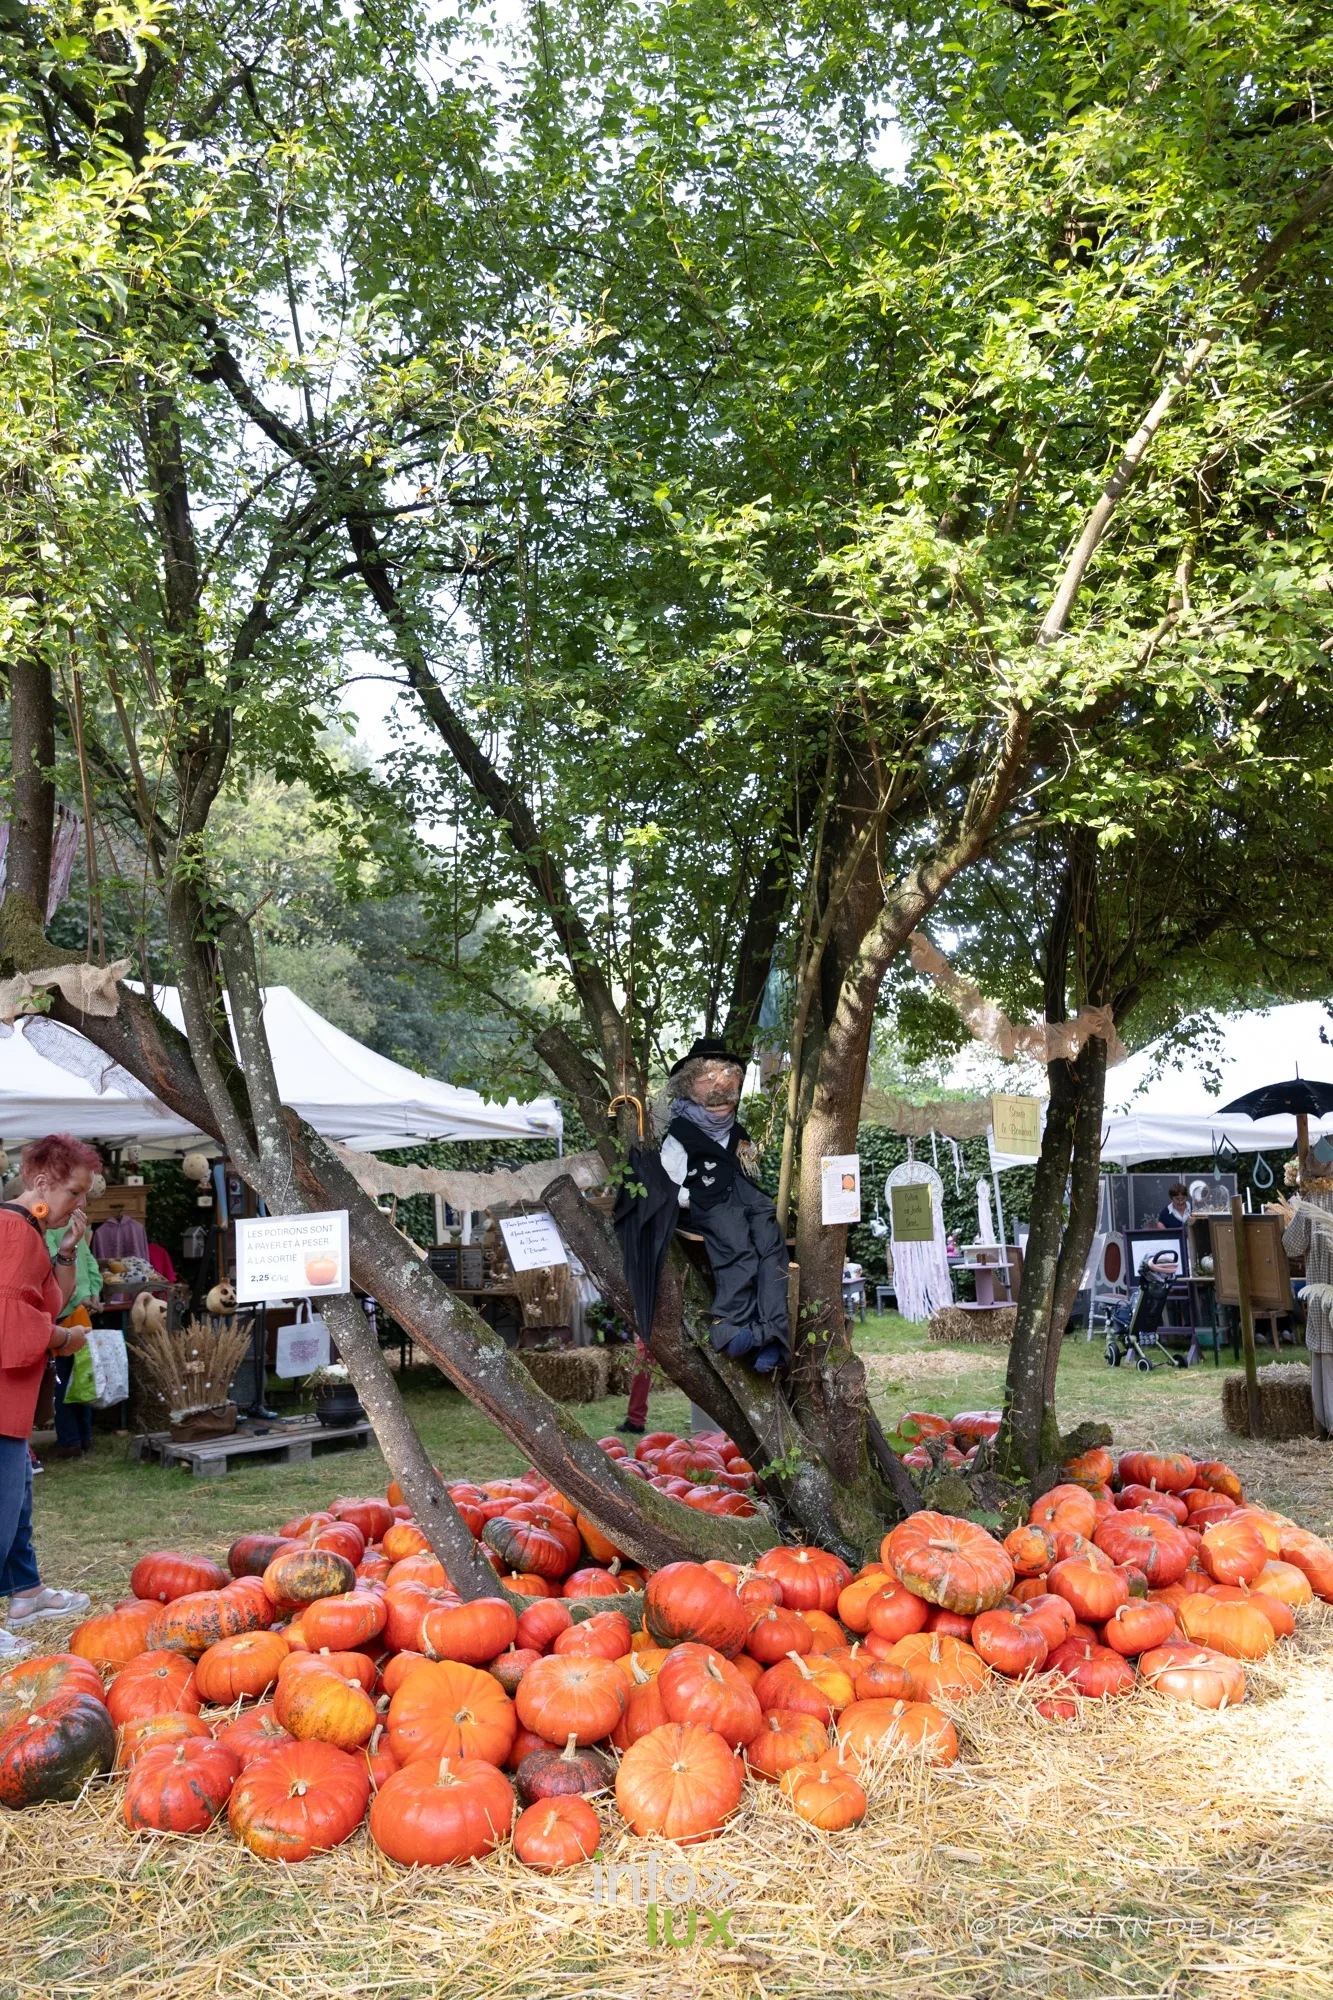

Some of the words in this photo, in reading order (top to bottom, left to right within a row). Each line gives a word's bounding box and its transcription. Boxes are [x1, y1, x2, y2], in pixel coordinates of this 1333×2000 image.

[247, 1229, 263, 1239] LES
[264, 1227, 308, 1237] POTIRONS
[310, 1224, 333, 1235] SONT
[255, 1241, 281, 1251] PAYER
[283, 1240, 293, 1249] ET
[302, 1237, 329, 1247] PESER
[255, 1256, 266, 1265] LA
[267, 1253, 298, 1264] SORTIE
[250, 1274, 270, 1283] 2,25
[271, 1274, 289, 1283] €/kg
